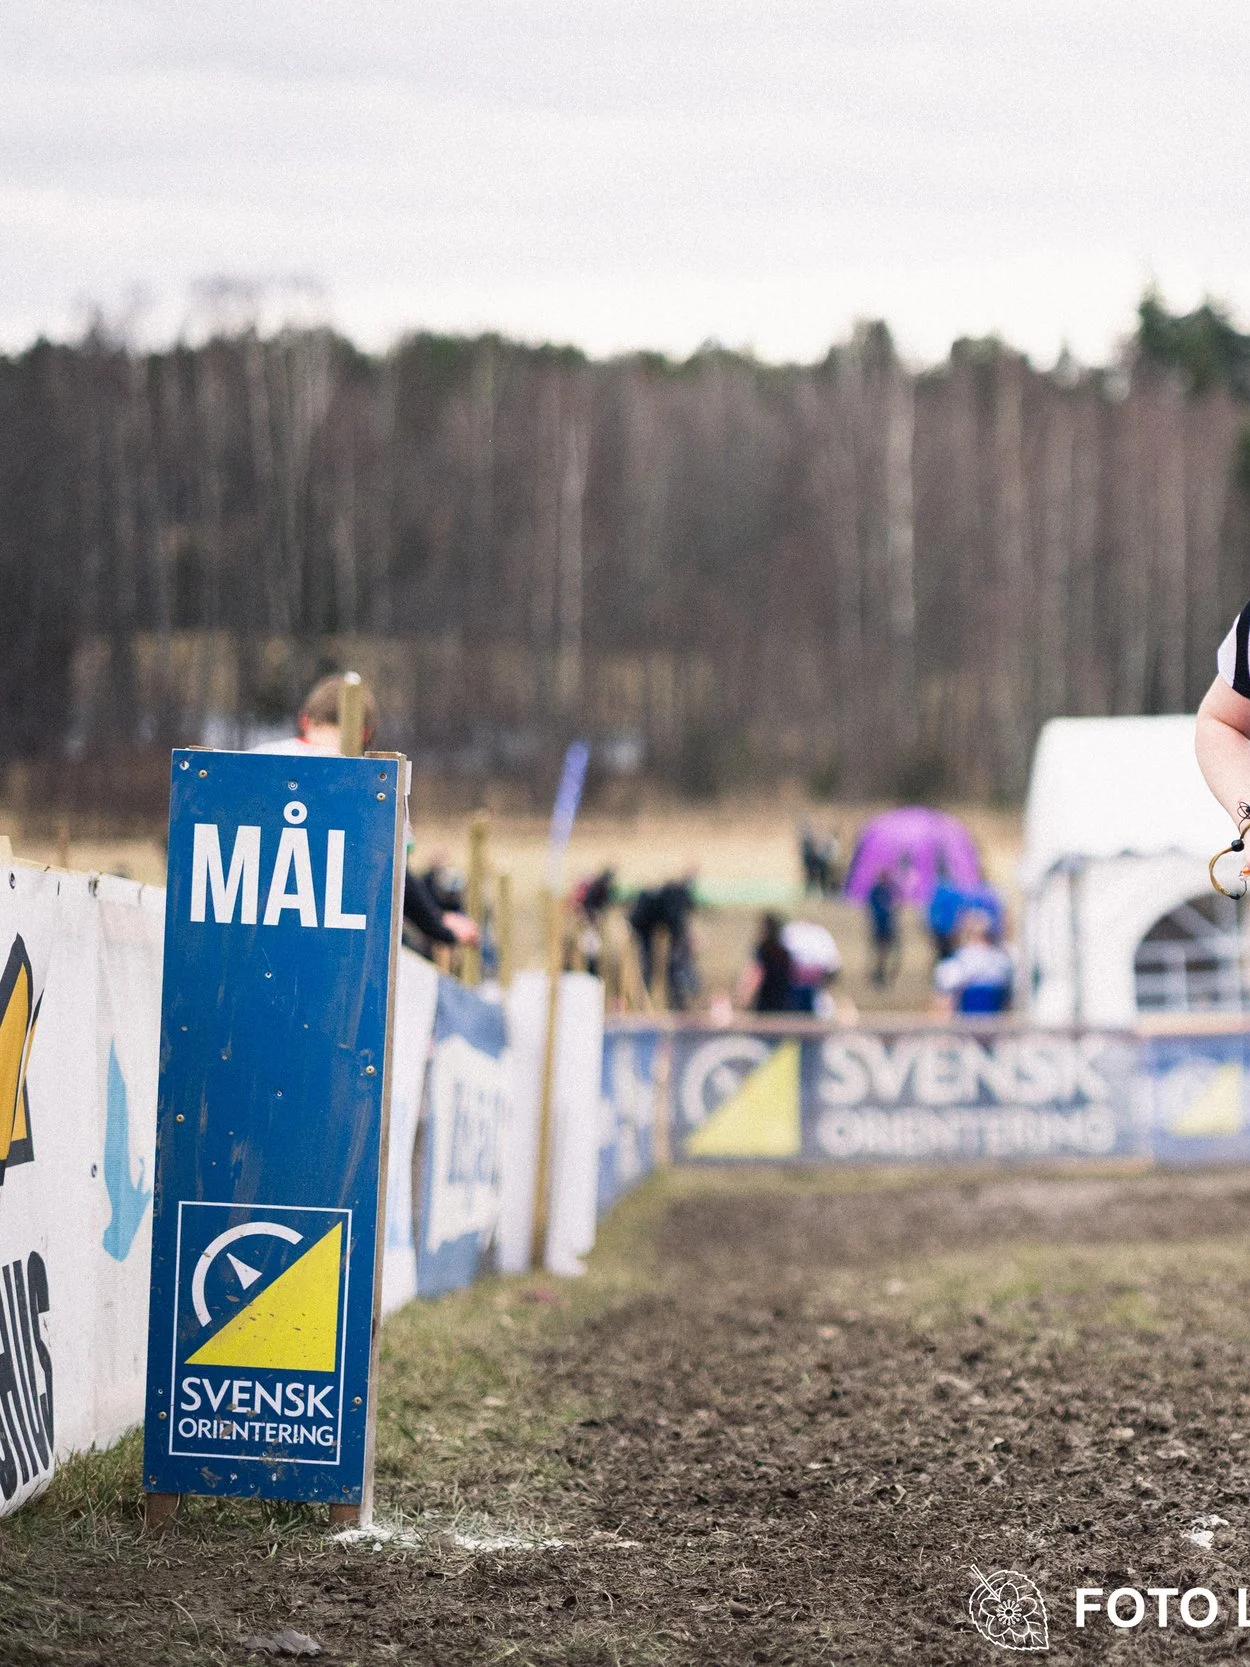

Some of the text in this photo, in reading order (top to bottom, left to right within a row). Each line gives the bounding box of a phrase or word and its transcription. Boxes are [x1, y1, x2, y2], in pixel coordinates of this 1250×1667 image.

[190, 801, 367, 930] MÅL
[818, 1032, 1111, 1106] SVENSK
[180, 1376, 335, 1419] SVENSK
[178, 1417, 334, 1447] ORIENTERING
